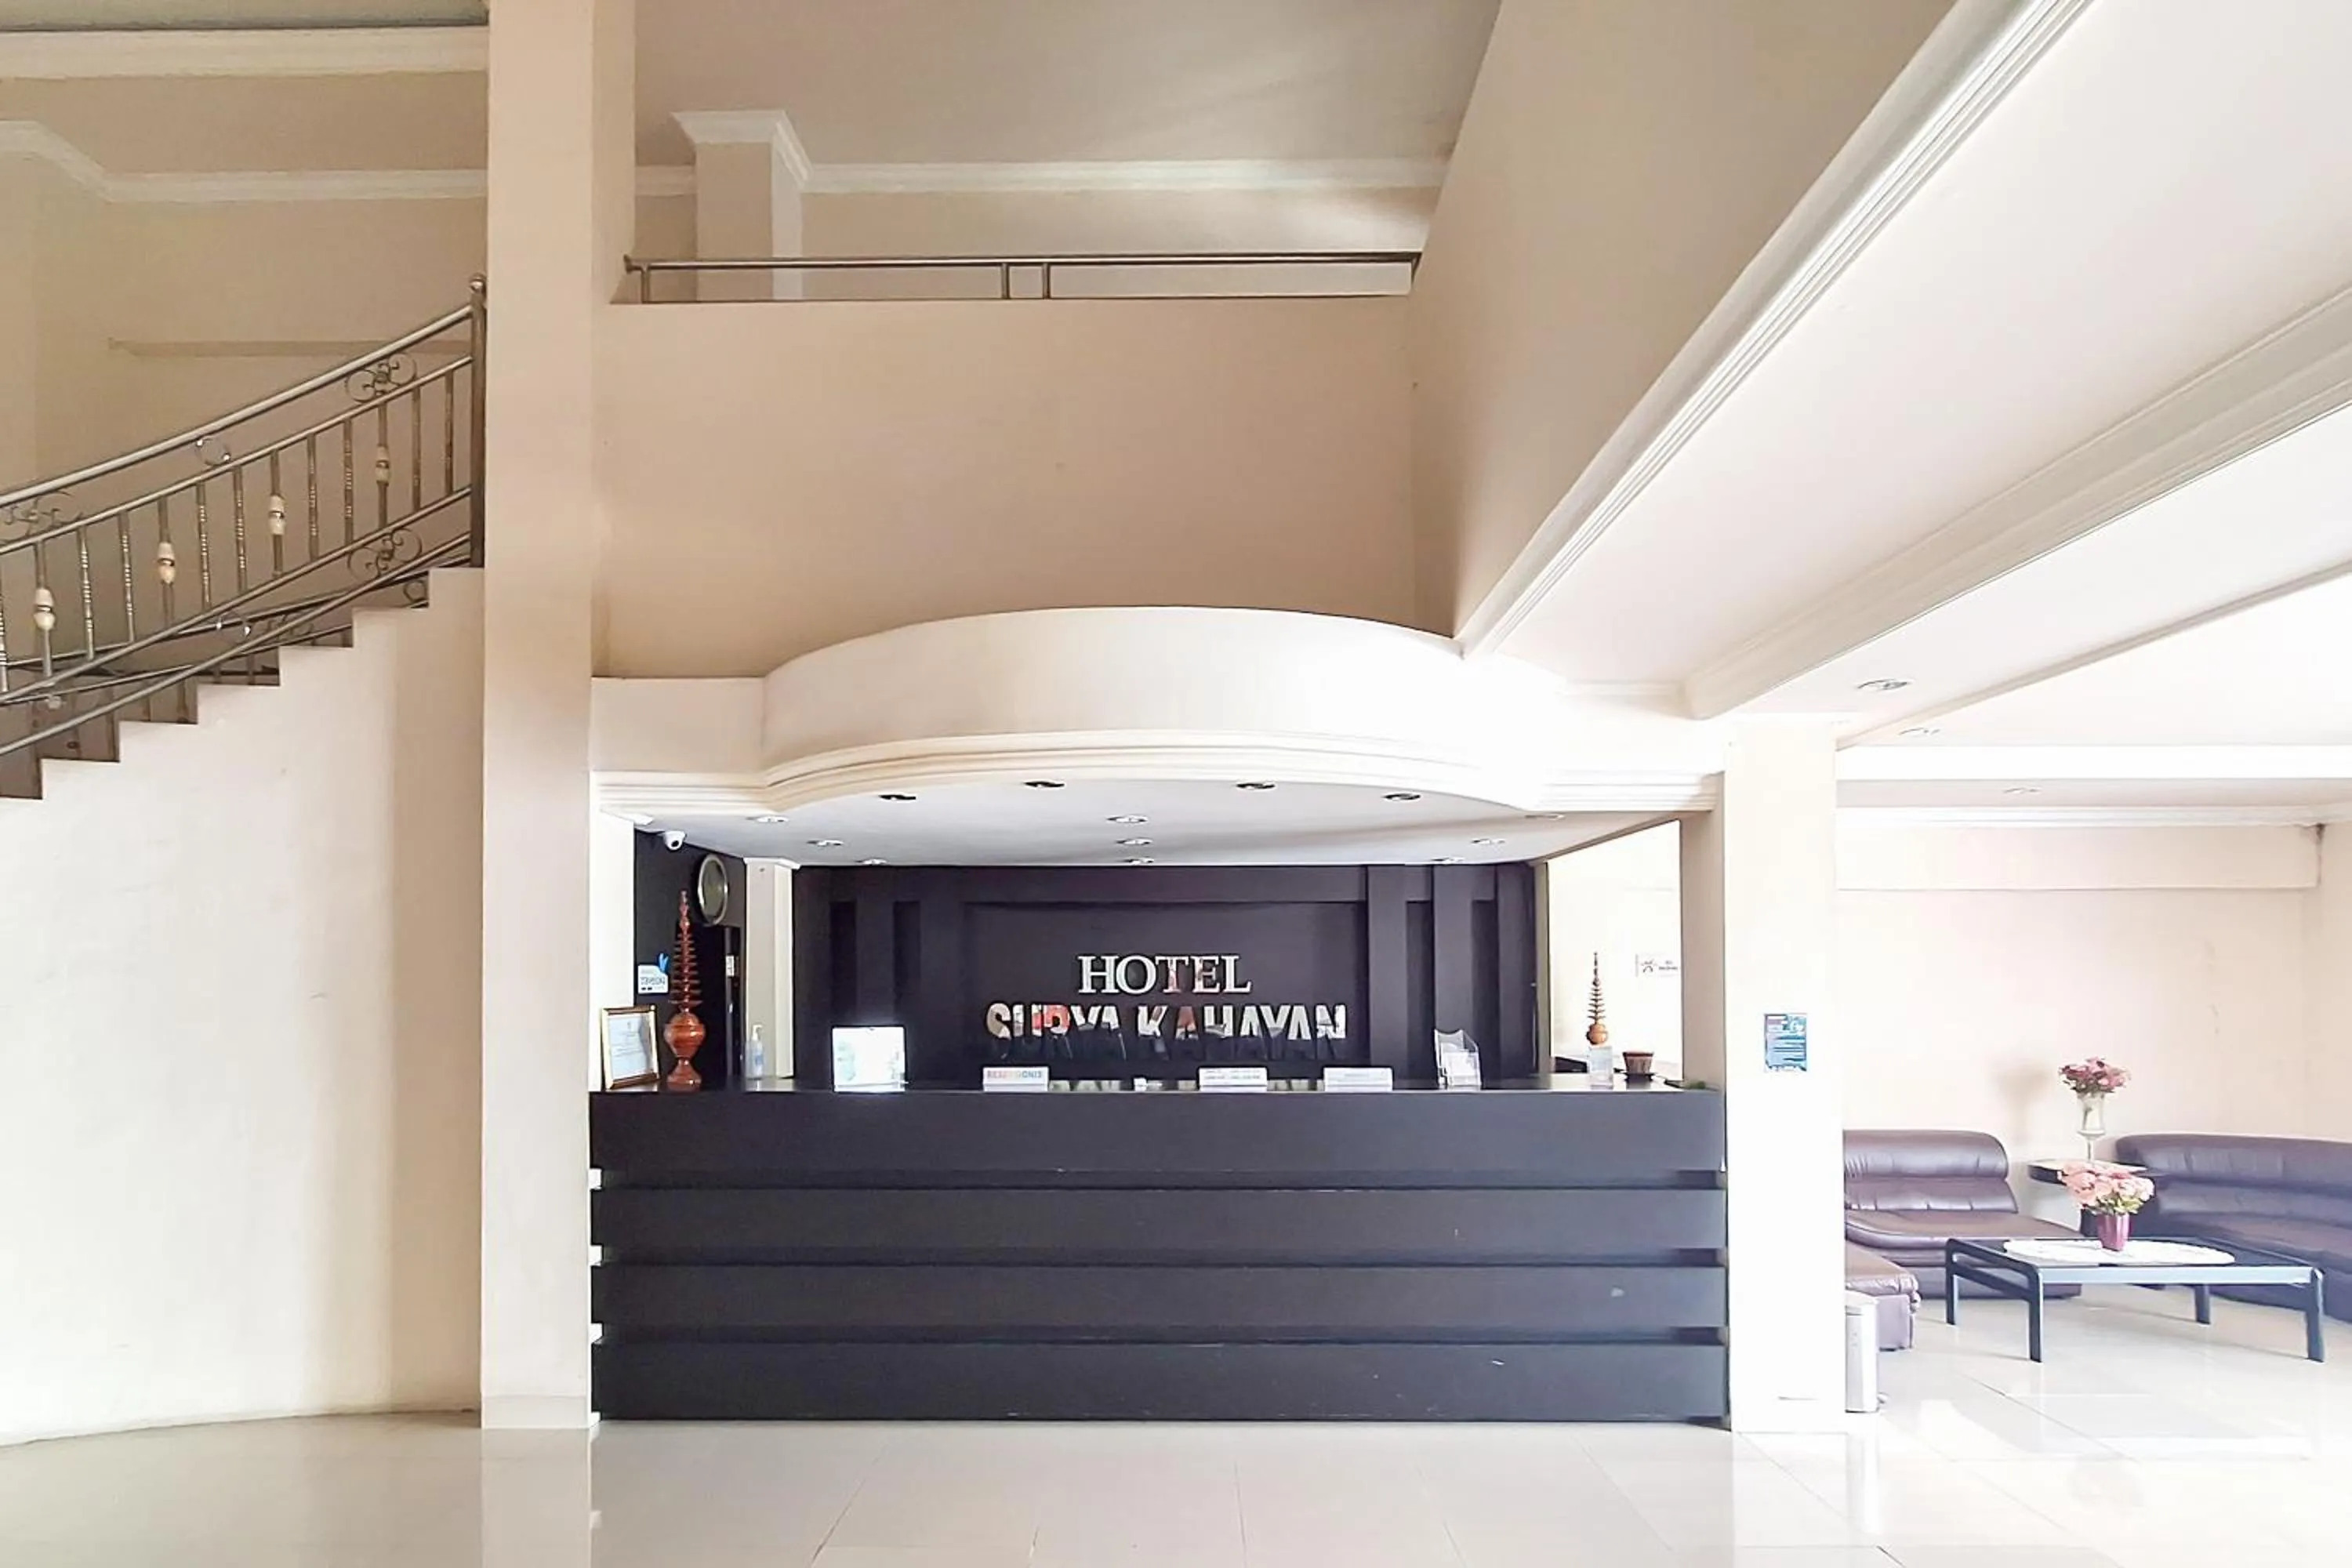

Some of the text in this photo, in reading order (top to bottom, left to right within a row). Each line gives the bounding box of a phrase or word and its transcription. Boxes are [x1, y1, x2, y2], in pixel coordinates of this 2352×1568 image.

[1077, 955, 1252, 995] HOTEL
[985, 1002, 1348, 1059] SURYA KAHAYAN
